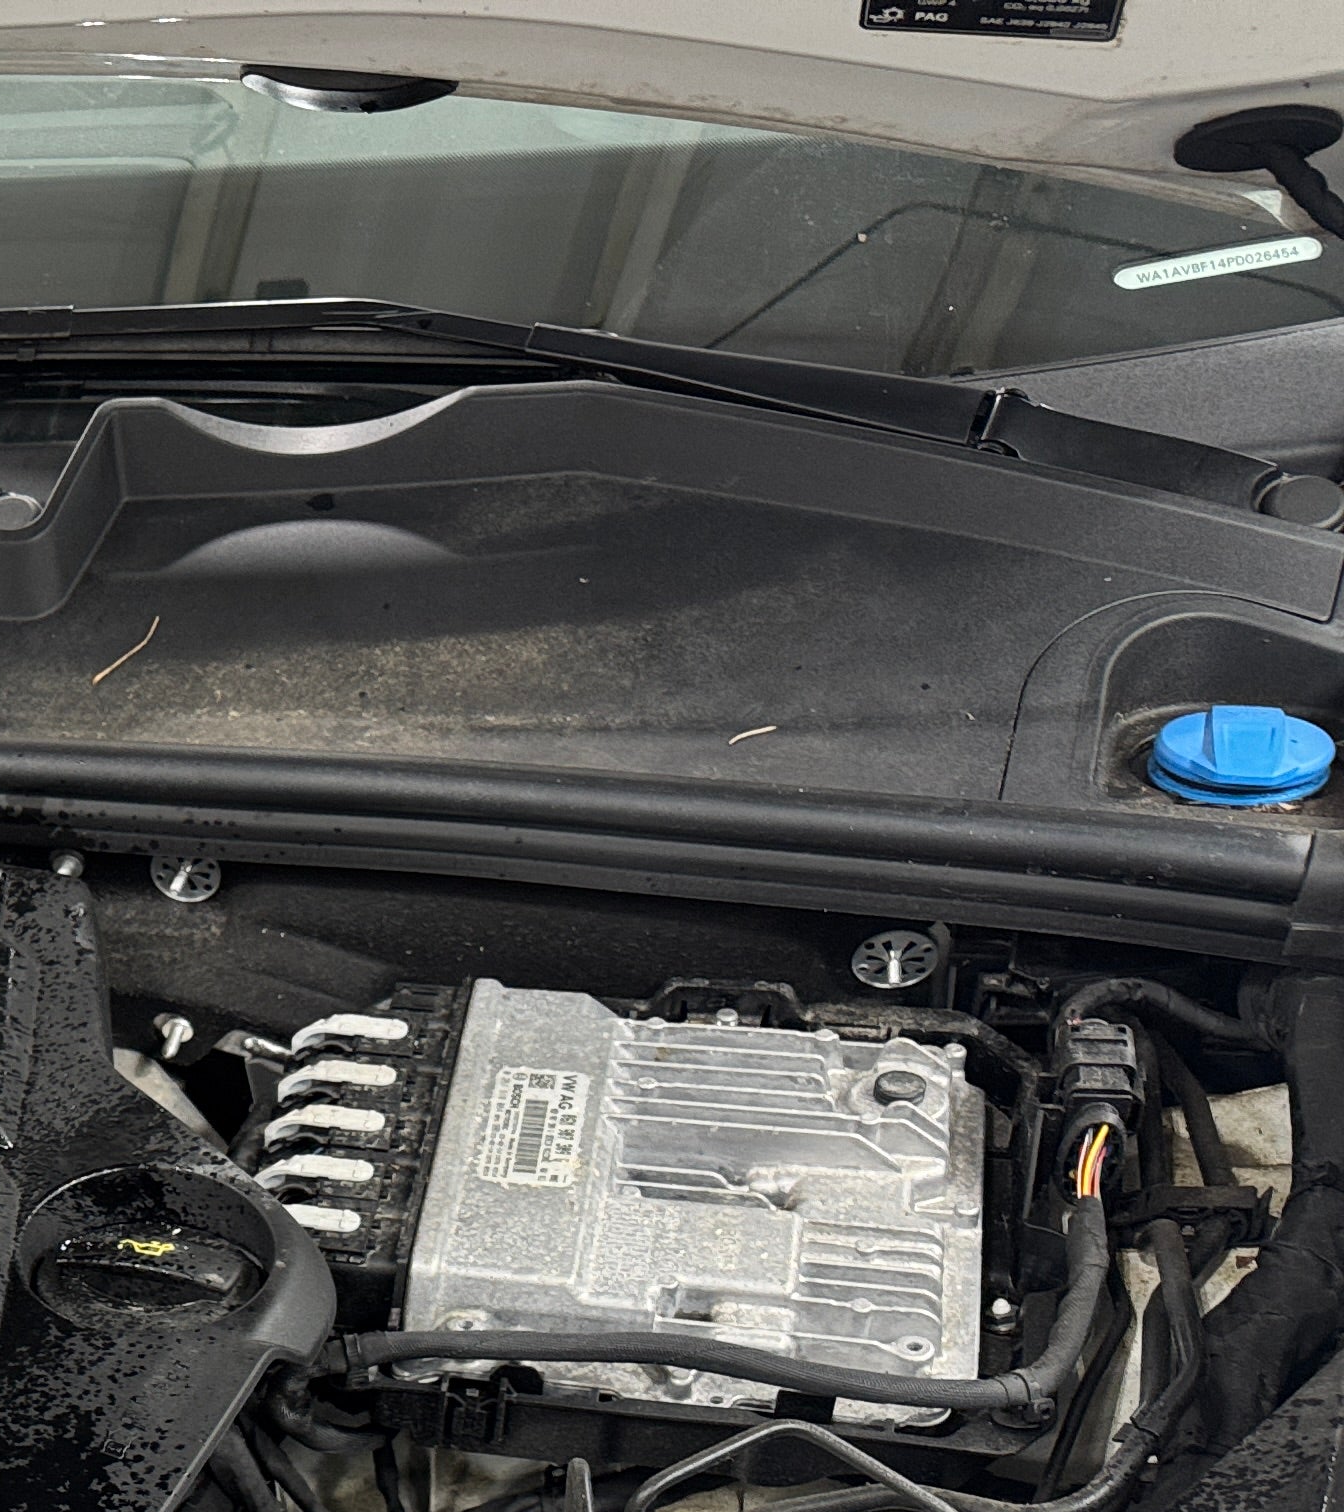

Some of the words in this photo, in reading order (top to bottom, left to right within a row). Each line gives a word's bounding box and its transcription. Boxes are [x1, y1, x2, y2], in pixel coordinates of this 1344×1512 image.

[1136, 246, 1300, 283] WA1AVBF14PD026454
[561, 1075, 578, 1094] VW
[510, 1084, 524, 1109] BOSCH
[558, 1094, 574, 1110] AG
